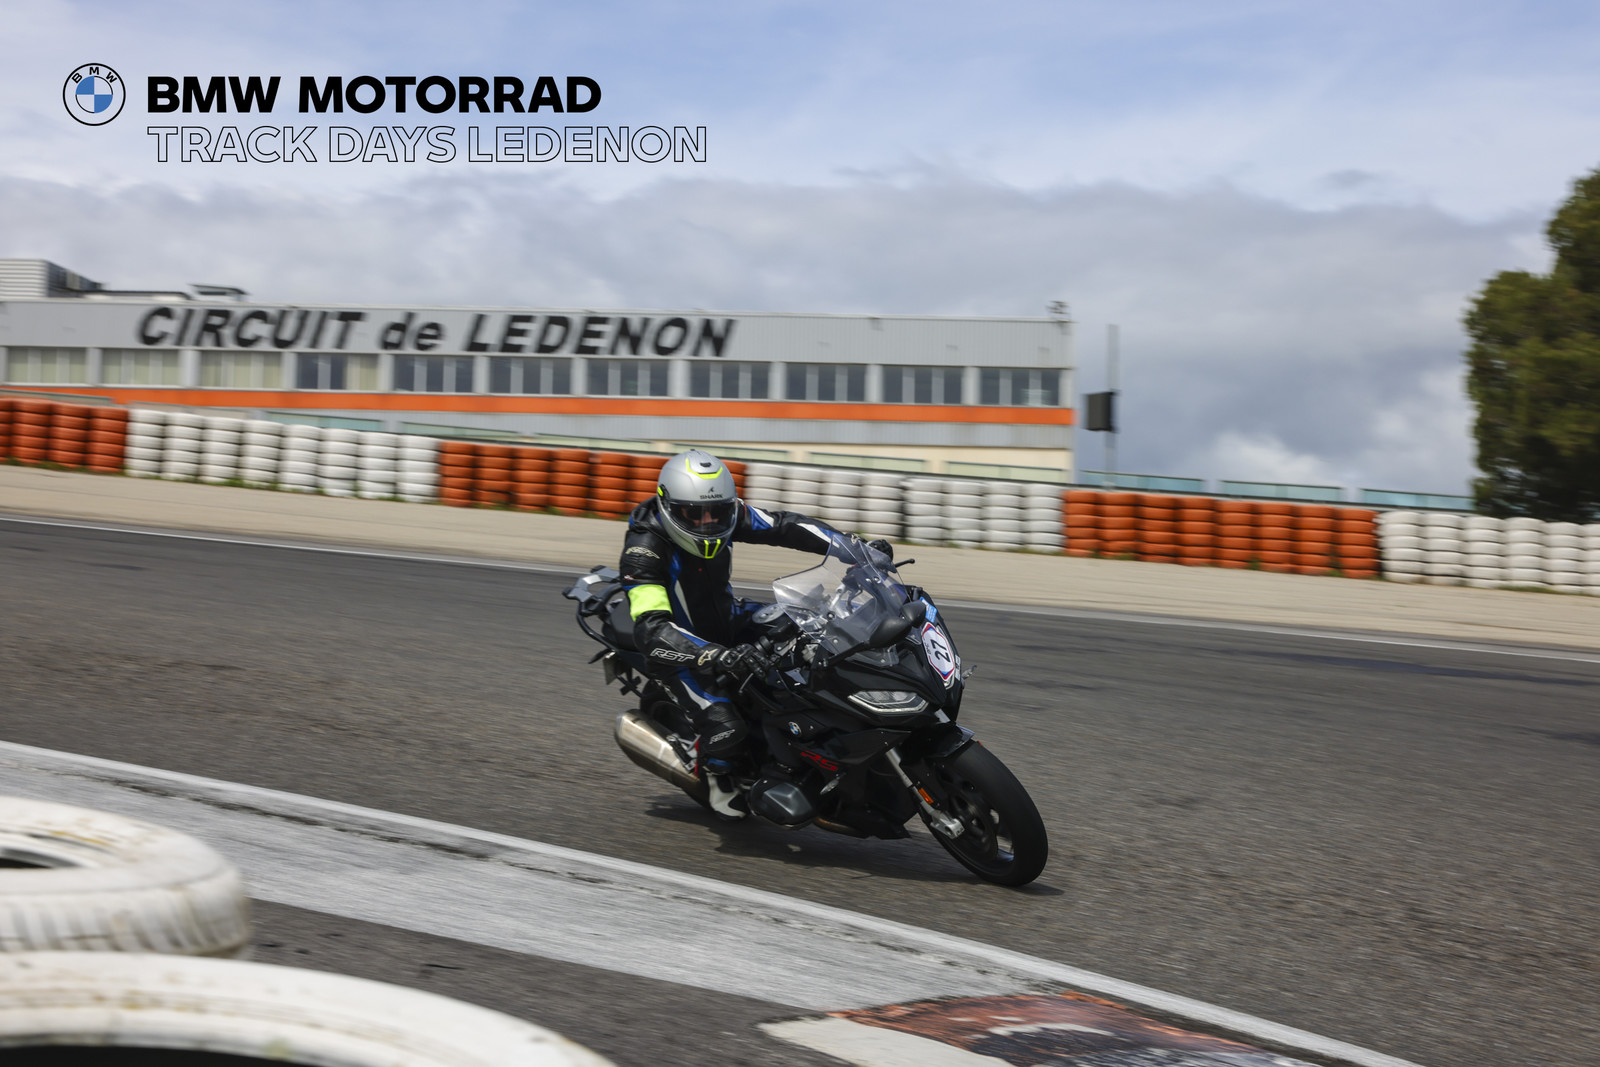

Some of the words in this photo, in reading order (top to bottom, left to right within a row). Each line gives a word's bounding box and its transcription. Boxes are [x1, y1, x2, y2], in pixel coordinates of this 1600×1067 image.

[137, 306, 366, 350] CIRCUIT
[380, 311, 445, 352] de
[465, 313, 736, 357] LEDENON
[650, 648, 696, 662] RST
[930, 638, 951, 663] 27
[800, 750, 839, 771] RS
